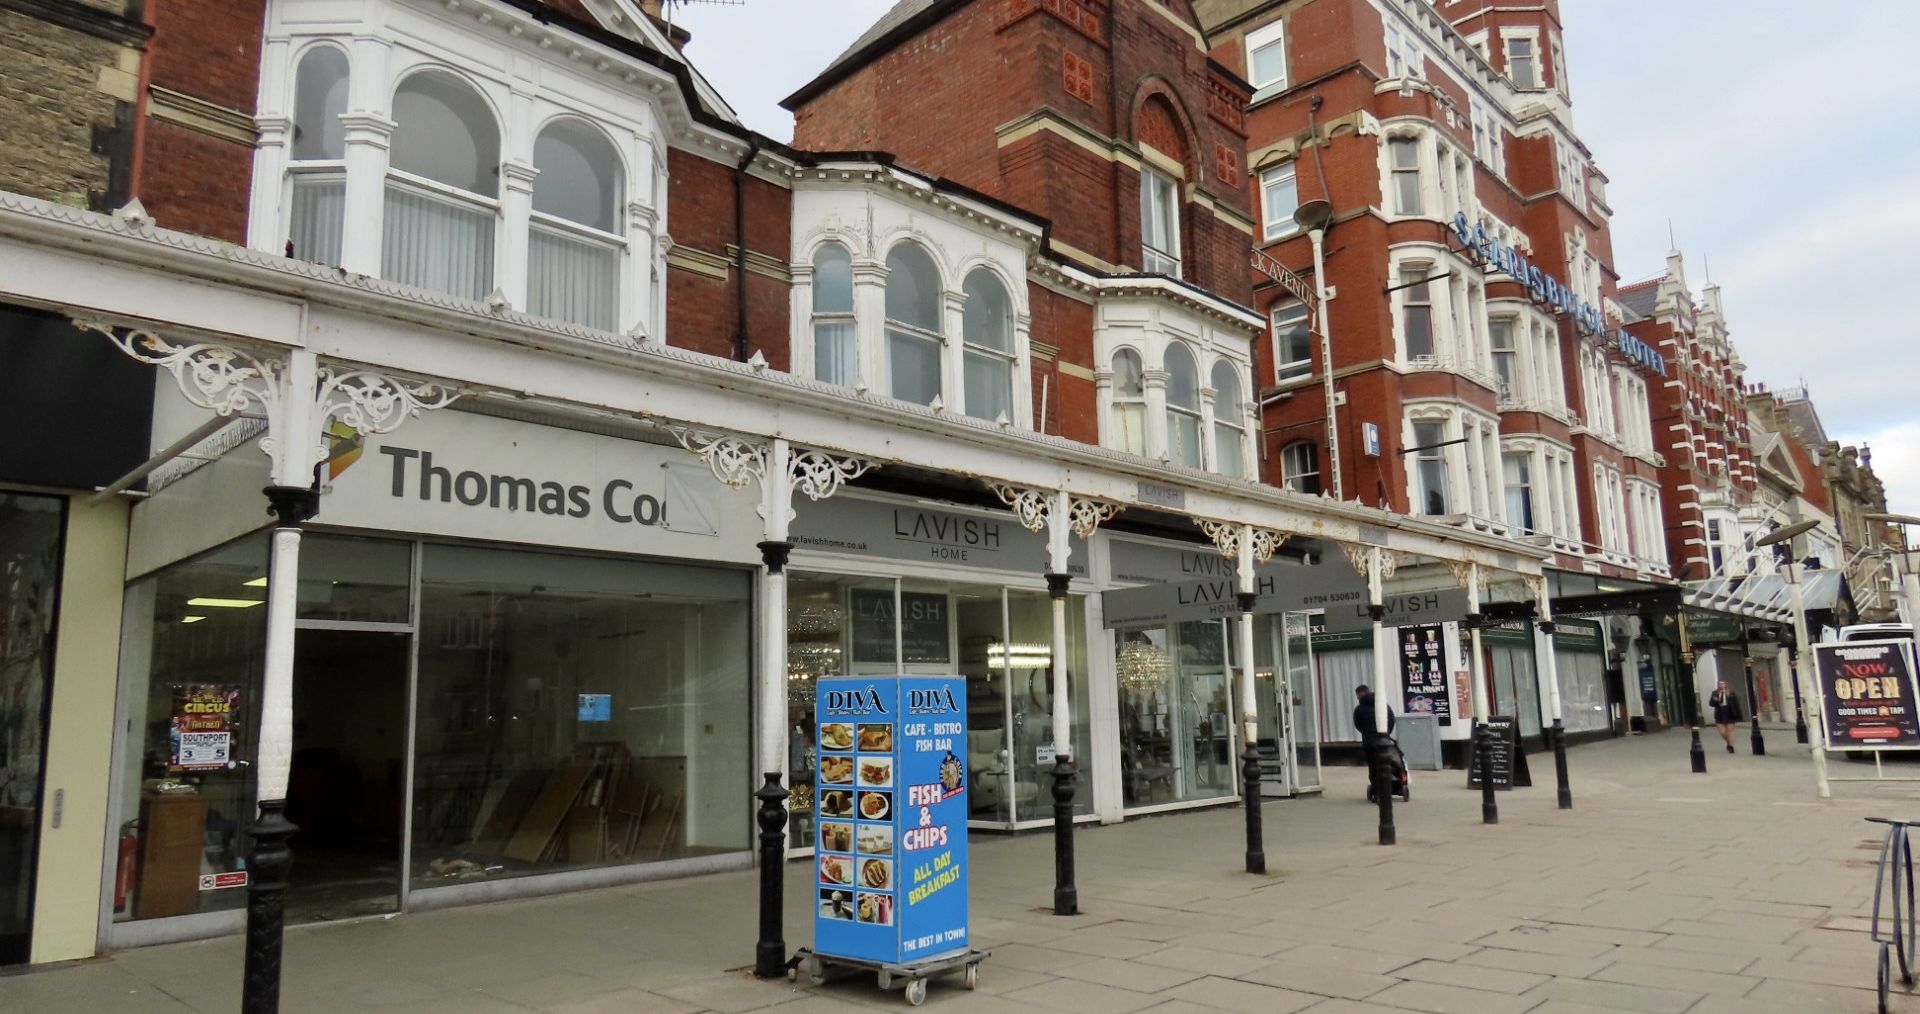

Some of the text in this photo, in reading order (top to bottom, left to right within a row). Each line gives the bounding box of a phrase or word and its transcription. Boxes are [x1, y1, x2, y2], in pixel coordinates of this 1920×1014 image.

[1455, 210, 1668, 377] SCARISBRICK HOTEL
[379, 445, 667, 526] Thomas Co
[894, 509, 1000, 548] LAVISH
[786, 535, 868, 550] ww.lavishhome.co.uk
[931, 547, 968, 561] HOME
[1181, 552, 1233, 577] LAVIS
[1177, 575, 1275, 605] LAVIH
[1356, 594, 1438, 617] LVISH
[1842, 663, 1886, 677] NOW
[824, 684, 889, 714] DIVA
[906, 684, 961, 713] DIVA
[1835, 677, 1900, 699] OPEN
[184, 703, 231, 713] CIRCUS
[1857, 707, 1878, 715] TIMES
[904, 723, 926, 737] CAFE
[934, 722, 962, 735] BISTRO
[1475, 721, 1511, 729] Teaway
[183, 733, 228, 742] SOUTHPORT
[915, 738, 952, 752] FISH BAR
[184, 749, 225, 759] 3 5
[908, 783, 942, 807] FISH
[919, 806, 932, 827] &
[903, 825, 948, 851] CHIPS
[914, 850, 951, 884] ALL DAY
[908, 864, 960, 906] BREAKFAST
[903, 939, 916, 952] THE
[918, 934, 934, 949] BEST
[935, 933, 943, 945] IN
